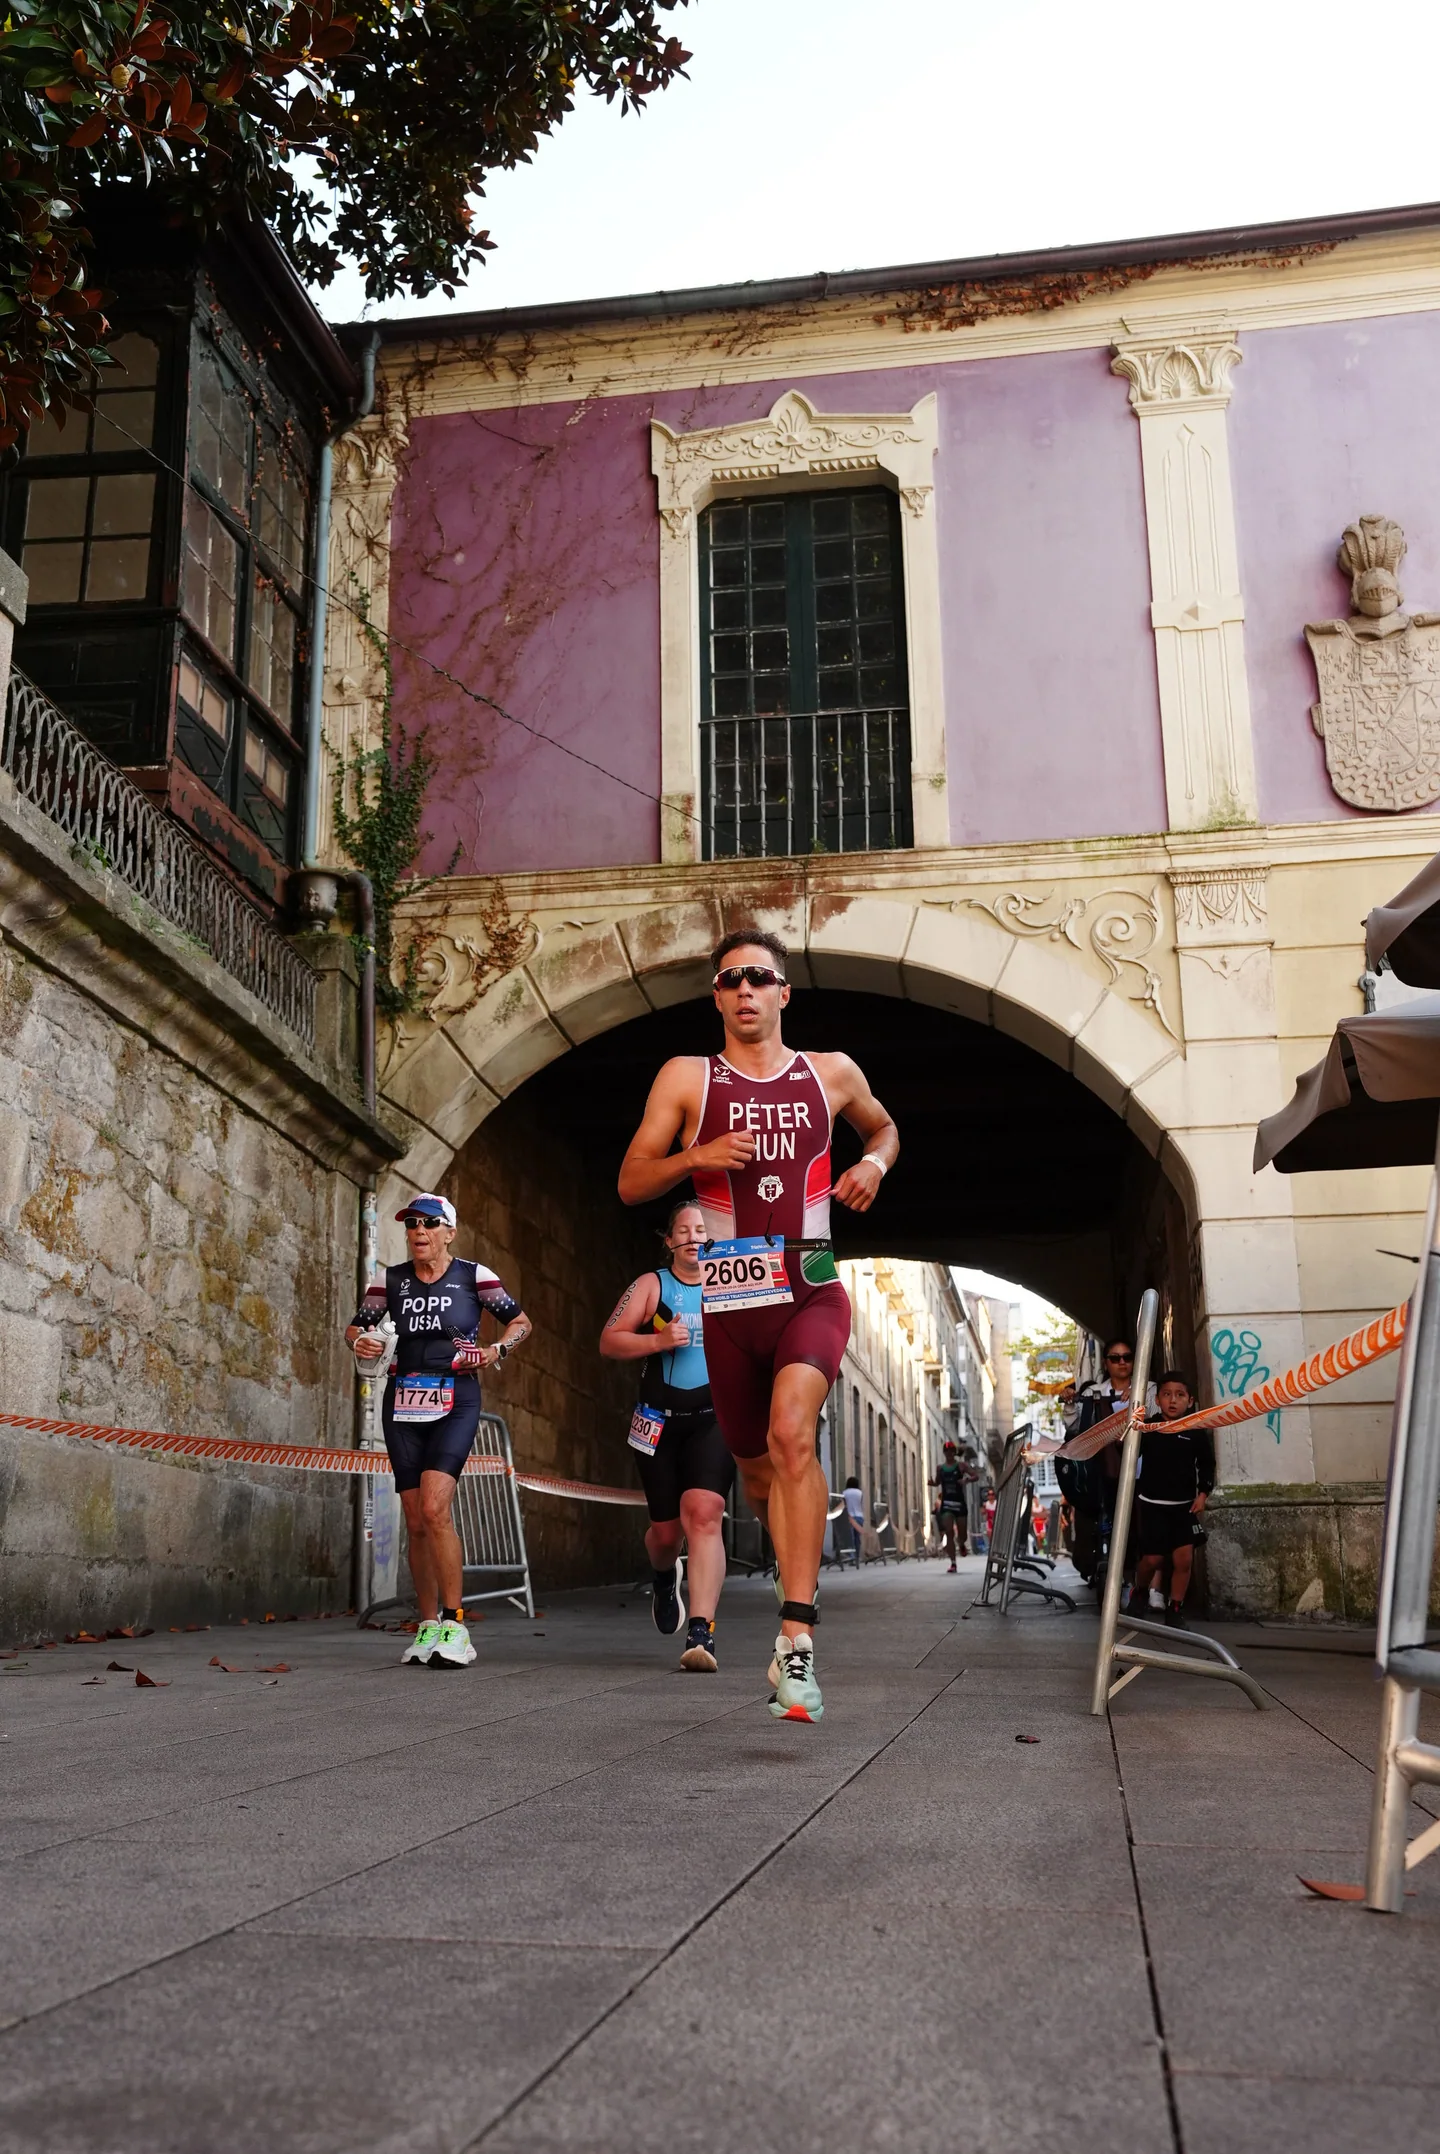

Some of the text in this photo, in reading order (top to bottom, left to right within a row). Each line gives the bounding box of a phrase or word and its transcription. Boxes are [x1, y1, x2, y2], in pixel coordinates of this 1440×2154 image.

[728, 1097, 812, 1131] PÉTER
[704, 1256, 766, 1287] 2606
[730, 1292, 755, 1300] TRIATHLON
[755, 1287, 787, 1296] PONTEVEDRA
[401, 1296, 452, 1315] POPP
[409, 1314, 442, 1332] USA
[398, 1390, 440, 1406] 1774
